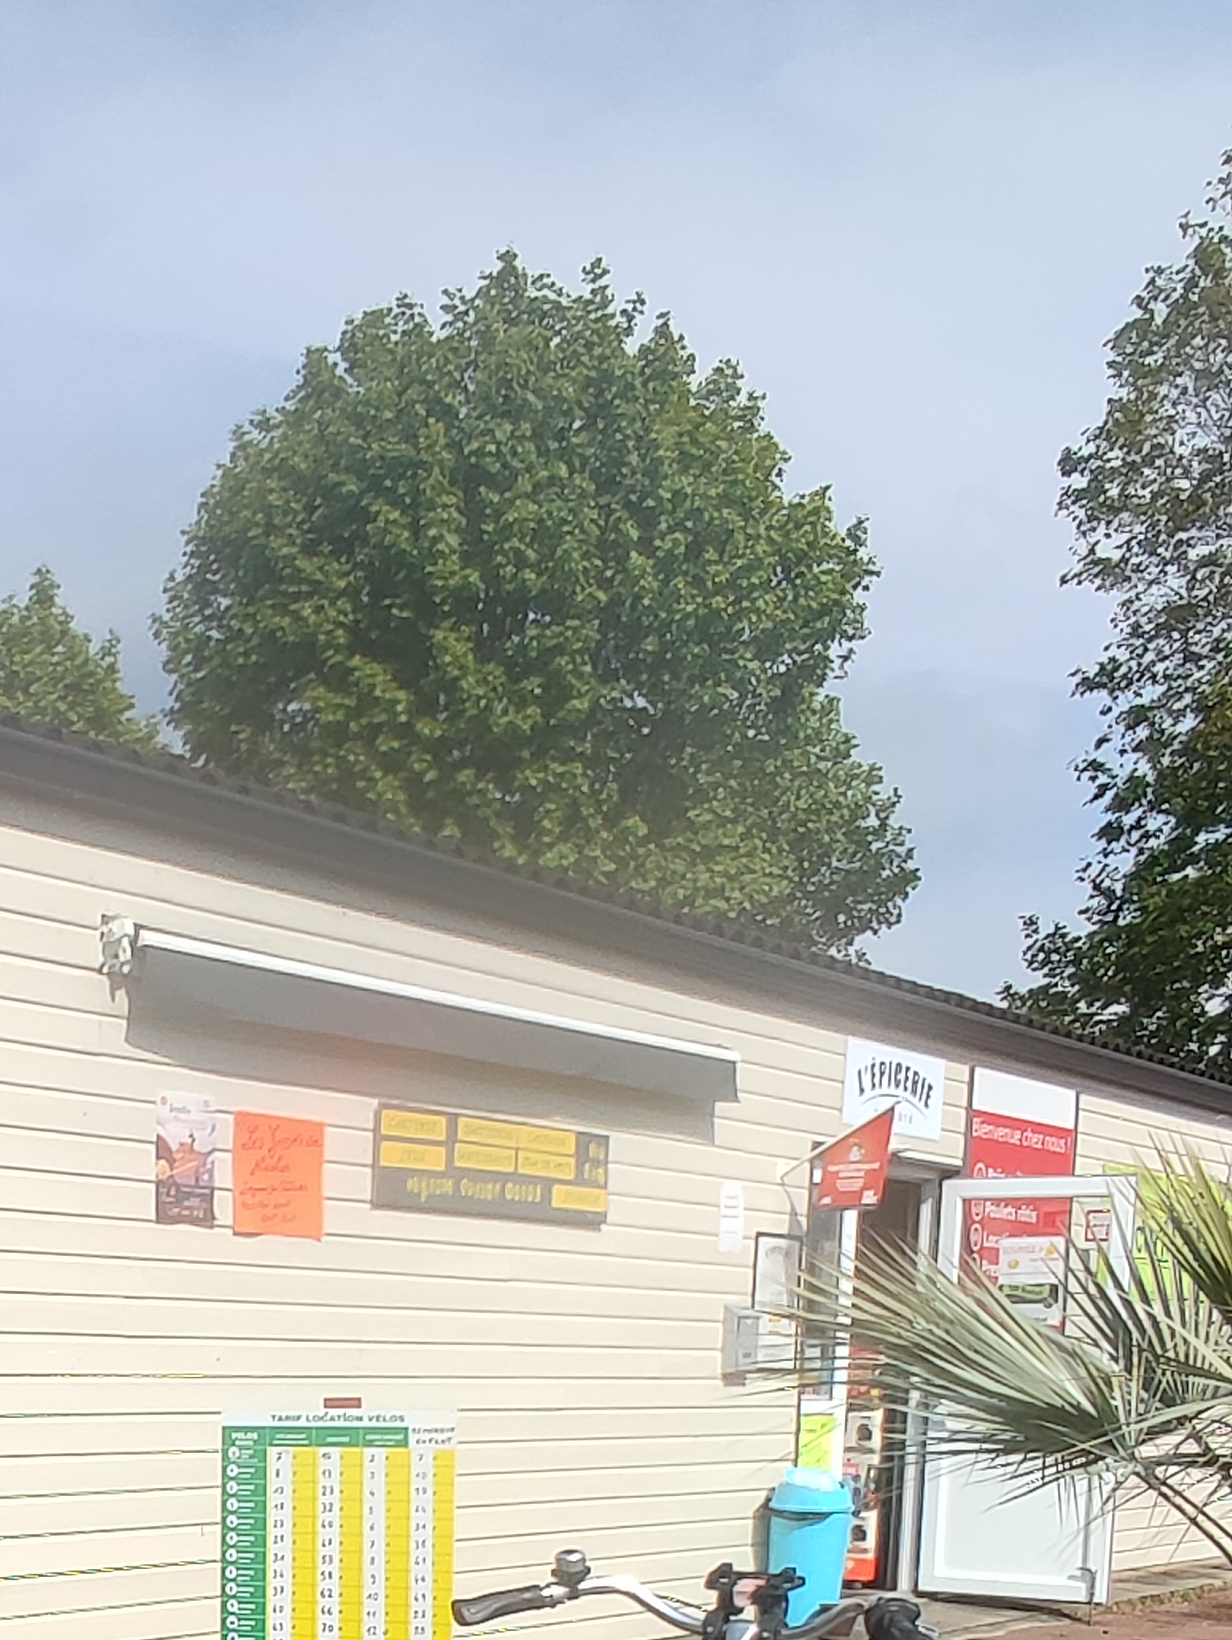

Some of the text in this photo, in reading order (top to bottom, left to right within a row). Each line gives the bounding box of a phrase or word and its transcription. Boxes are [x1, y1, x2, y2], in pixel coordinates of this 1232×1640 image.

[972, 1117, 1021, 1146] Bienvenue
[1022, 1127, 1044, 1149] chez
[1044, 1135, 1066, 1154] nous
[321, 1502, 333, 1514] 32
[320, 1588, 333, 1599] 62
[321, 1623, 334, 1633] 70
